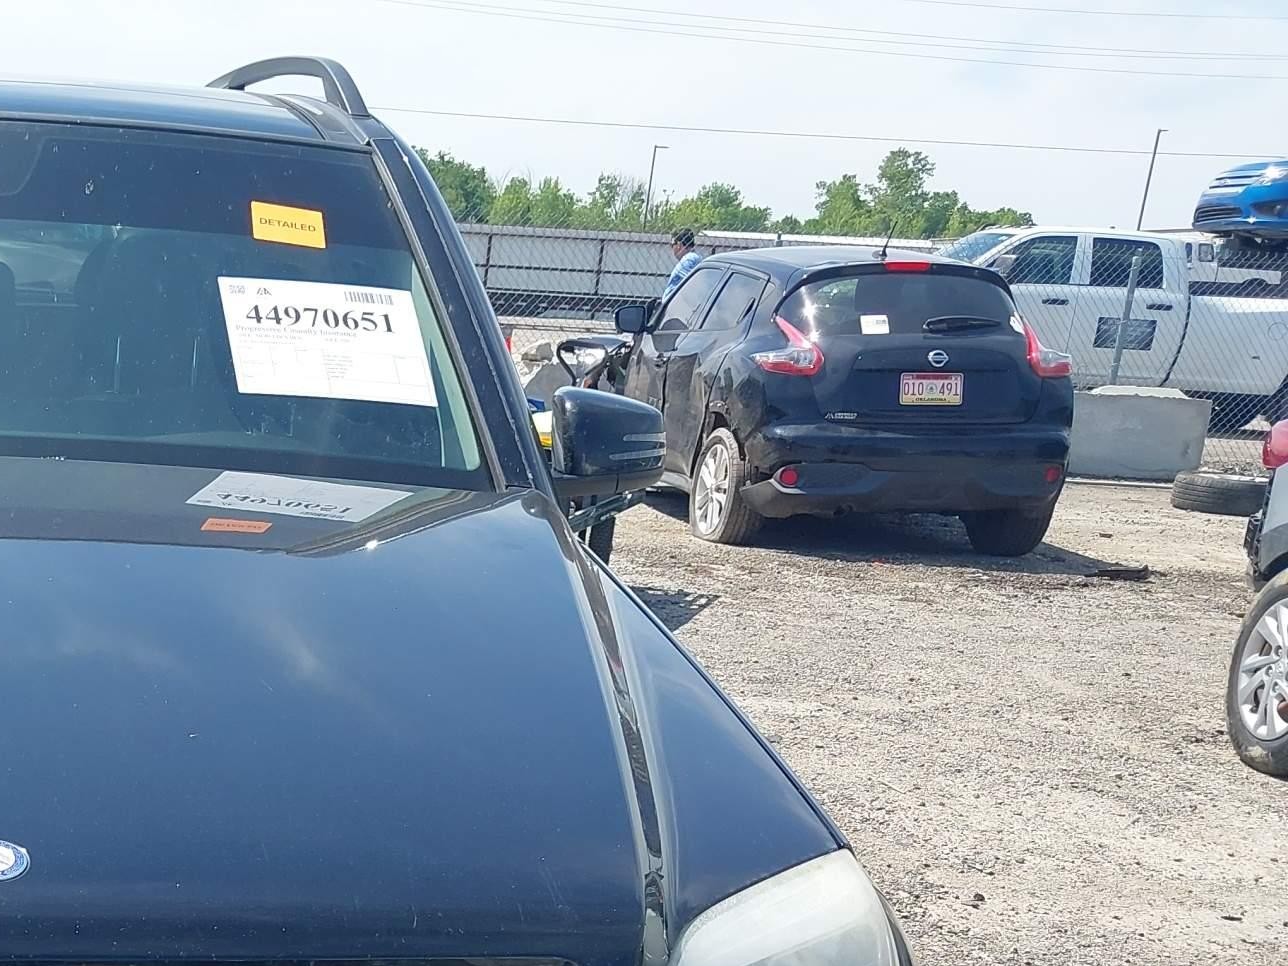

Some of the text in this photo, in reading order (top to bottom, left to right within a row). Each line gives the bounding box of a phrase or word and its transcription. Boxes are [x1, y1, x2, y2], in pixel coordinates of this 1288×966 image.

[259, 217, 316, 232] DETAILED
[245, 304, 396, 334] 44970651
[939, 382, 959, 396] 491
